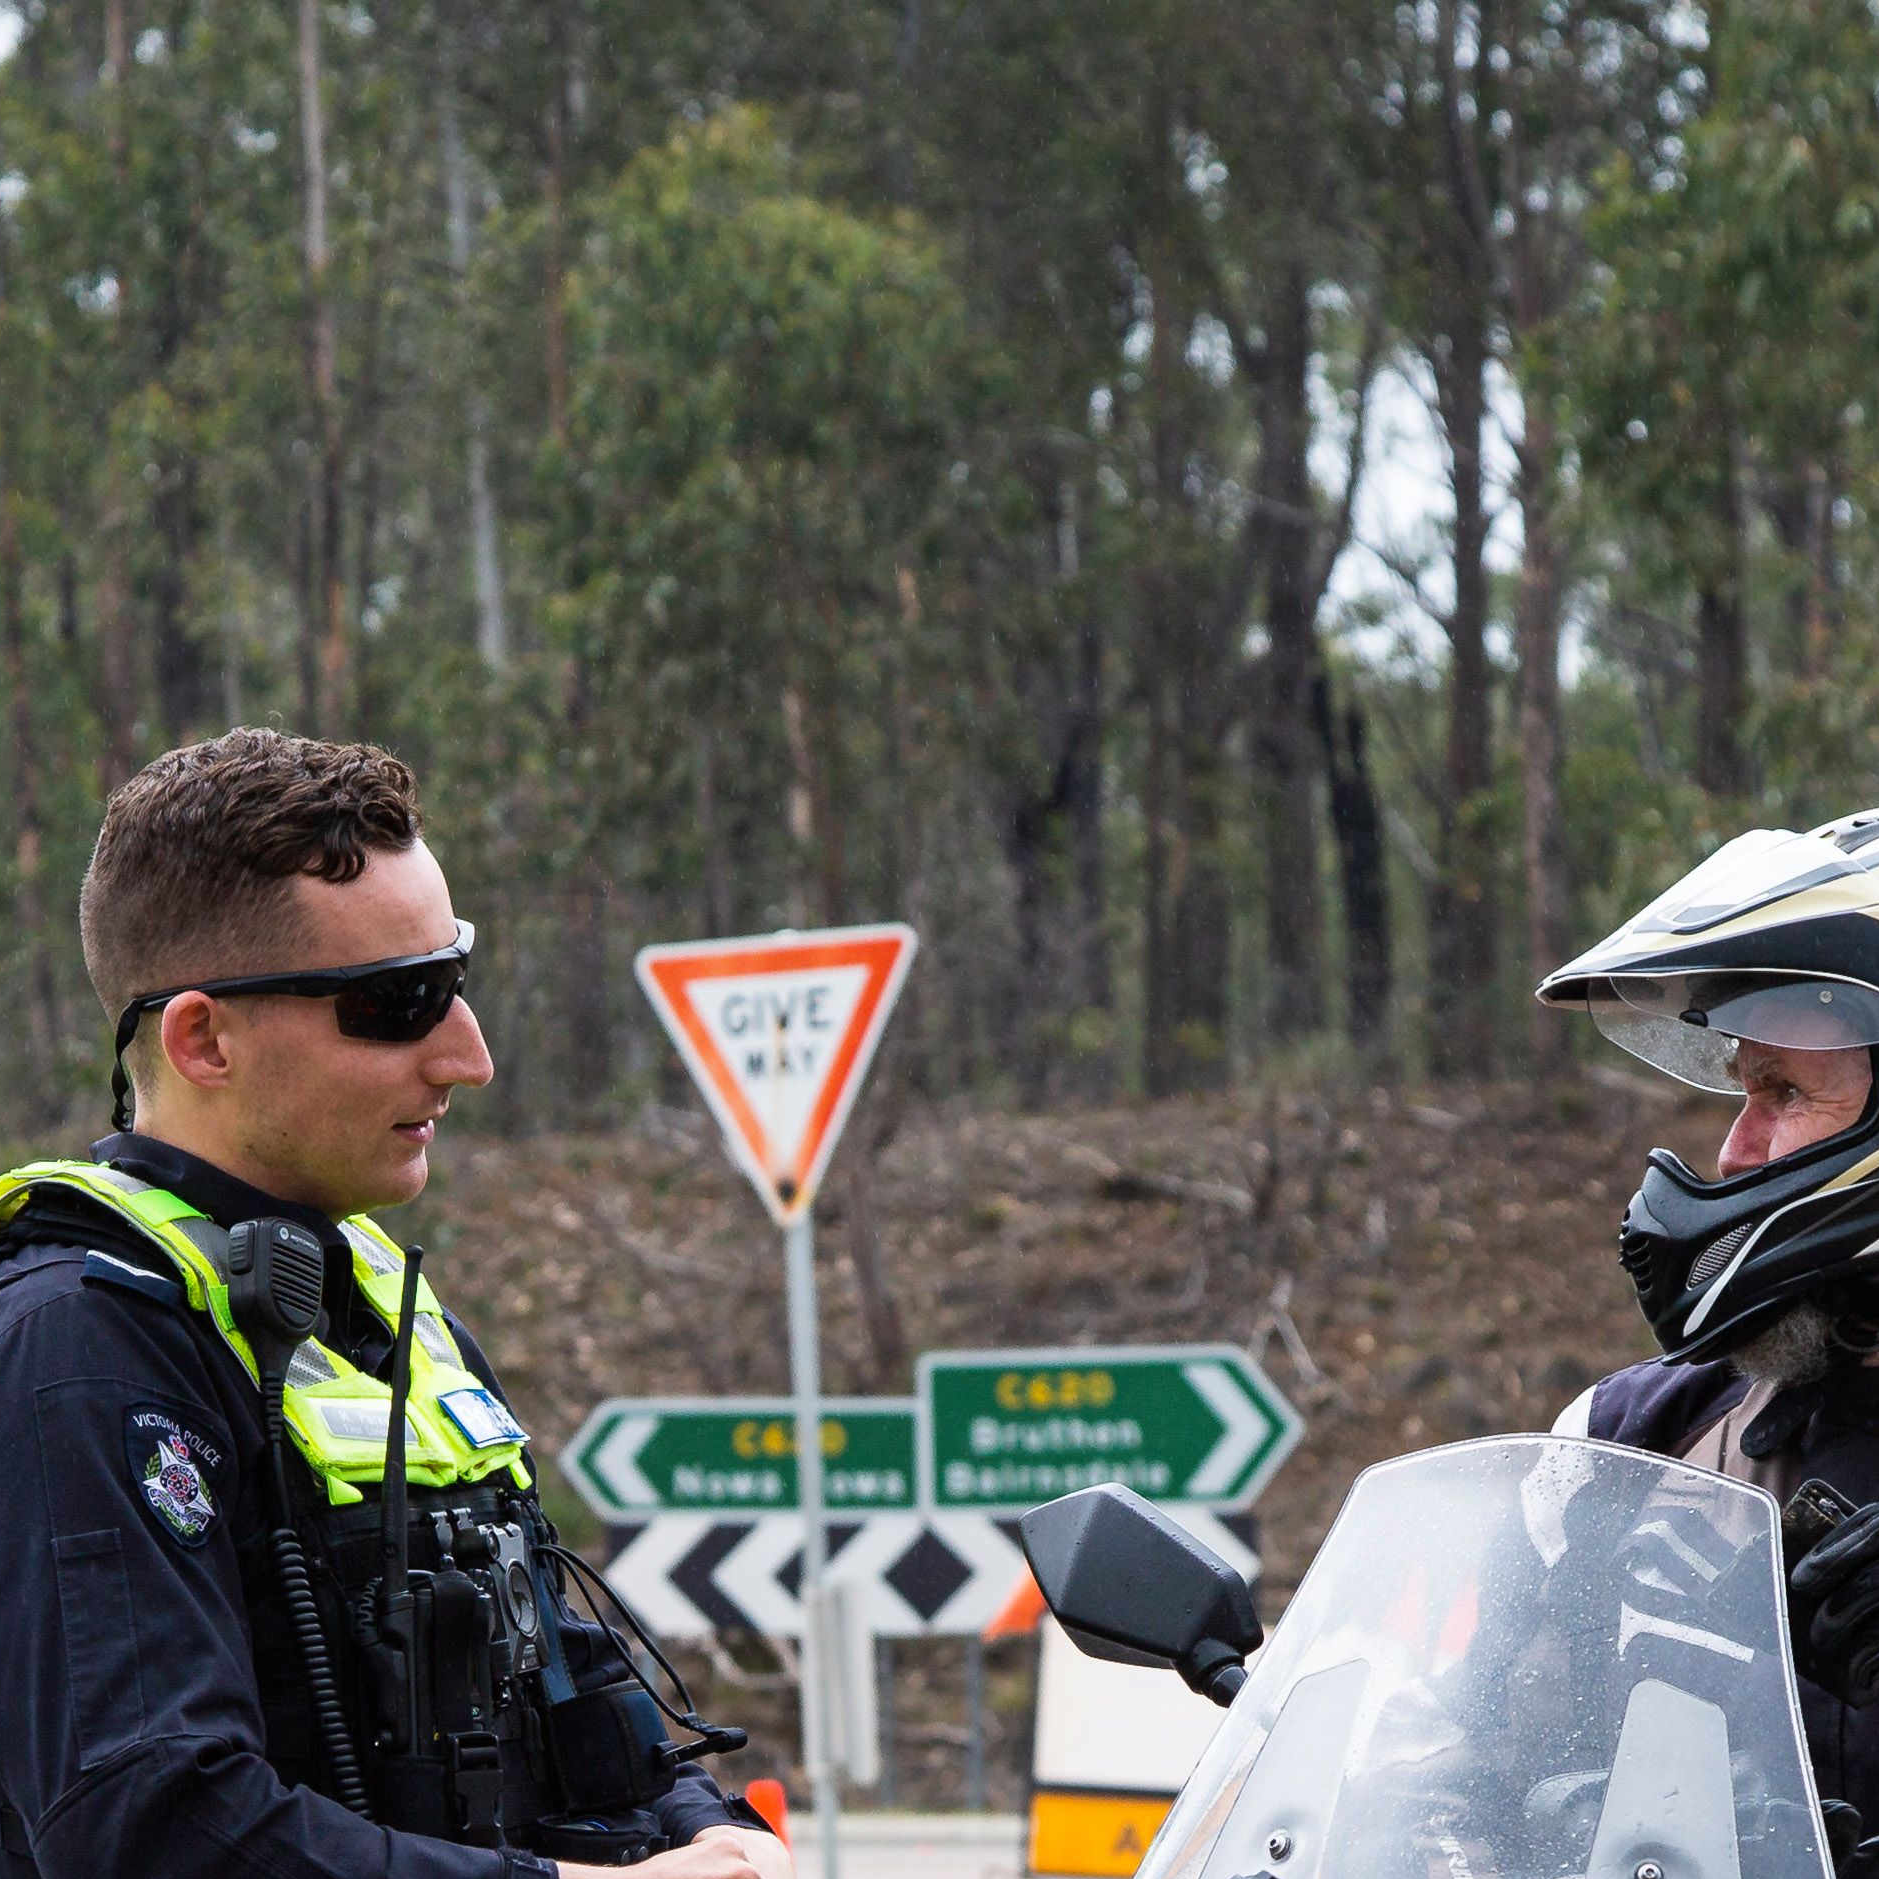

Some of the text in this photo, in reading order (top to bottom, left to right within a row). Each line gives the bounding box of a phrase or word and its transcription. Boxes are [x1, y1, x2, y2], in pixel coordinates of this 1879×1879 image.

[721, 985, 834, 1037] GIVE
[745, 1043, 823, 1079] WAY
[994, 1371, 1116, 1412] C620
[132, 1413, 222, 1468] VICTORIA POLICE
[731, 1420, 849, 1461] C60
[970, 1415, 1143, 1455] Bruthen
[672, 1465, 908, 1499] Nowa owa
